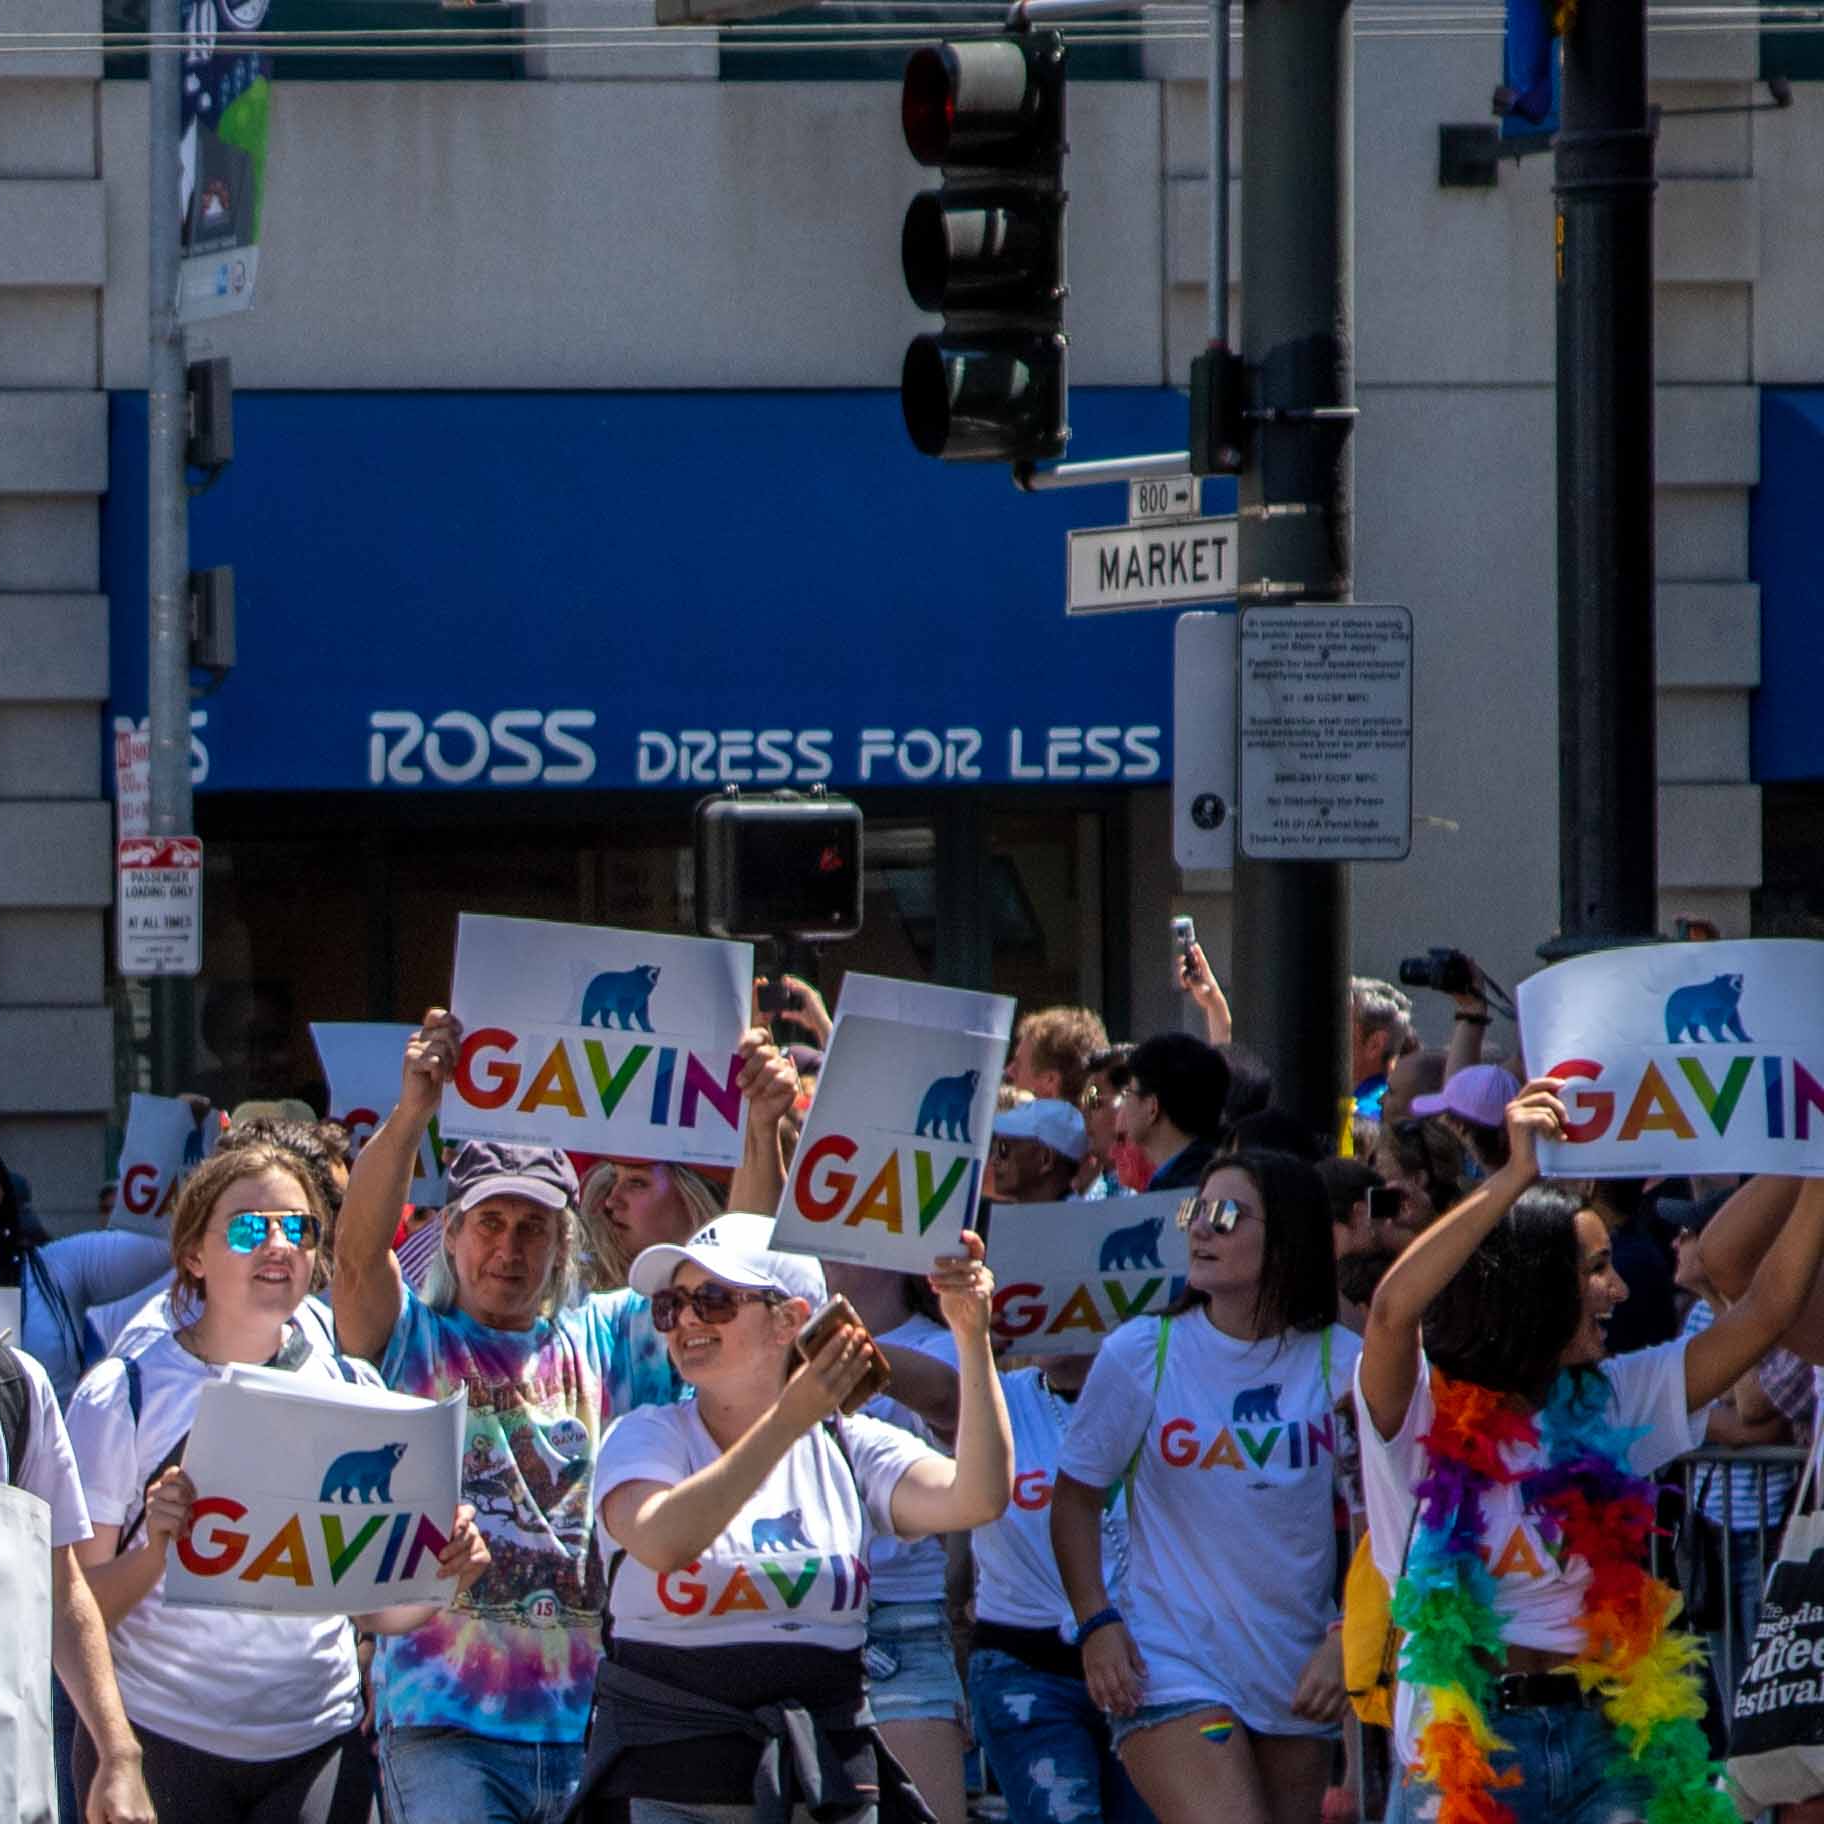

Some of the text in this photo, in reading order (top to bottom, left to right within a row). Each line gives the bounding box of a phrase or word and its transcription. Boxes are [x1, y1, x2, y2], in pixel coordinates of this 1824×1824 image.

[1138, 482, 1169, 514] 800
[1098, 536, 1228, 592] MARKET
[368, 708, 1161, 785] ROSS DRESS FOR LESS
[452, 1027, 746, 1133] GAVIN
[1160, 1413, 1334, 1471] GAVIN
[535, 1600, 553, 1616] 15
